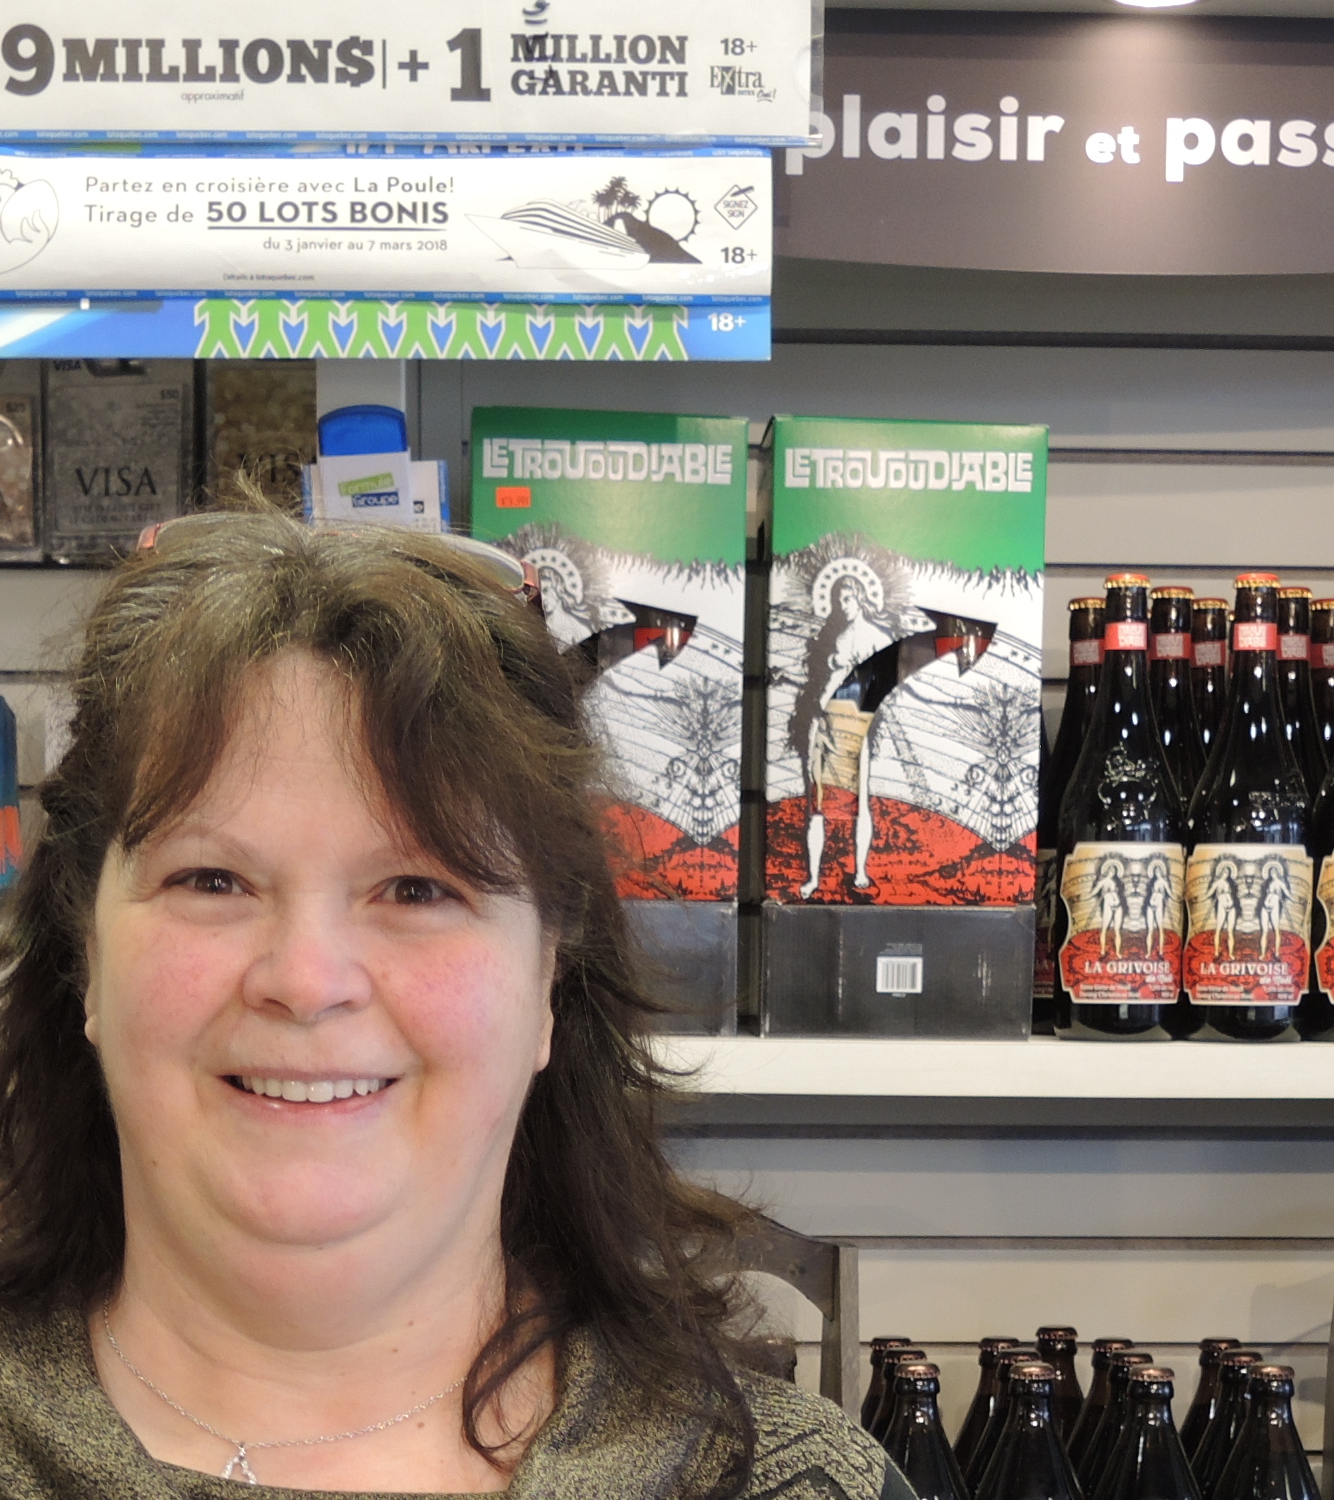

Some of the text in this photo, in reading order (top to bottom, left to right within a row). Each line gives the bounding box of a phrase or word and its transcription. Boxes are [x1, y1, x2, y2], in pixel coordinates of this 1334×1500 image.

[510, 34, 689, 65] MILLION
[720, 37, 758, 55] 18+
[0, 23, 56, 97] 9
[446, 27, 492, 102] 1
[510, 68, 689, 98] GARANTI
[180, 90, 245, 103] approximatif
[785, 93, 1065, 176] plaisir
[1085, 125, 1141, 165] et
[85, 176, 455, 194] Partez en croisière avec La Poule!
[84, 200, 450, 229] Tirage de 50 LOTS BONIS
[263, 238, 448, 254] du 3 janvier au 7 mars 2018
[720, 246, 758, 264] 18+
[707, 312, 747, 332] 18+
[74, 467, 158, 497] VISA
[353, 492, 399, 506] Groupe
[1084, 961, 1171, 975] LA GRIVOISE
